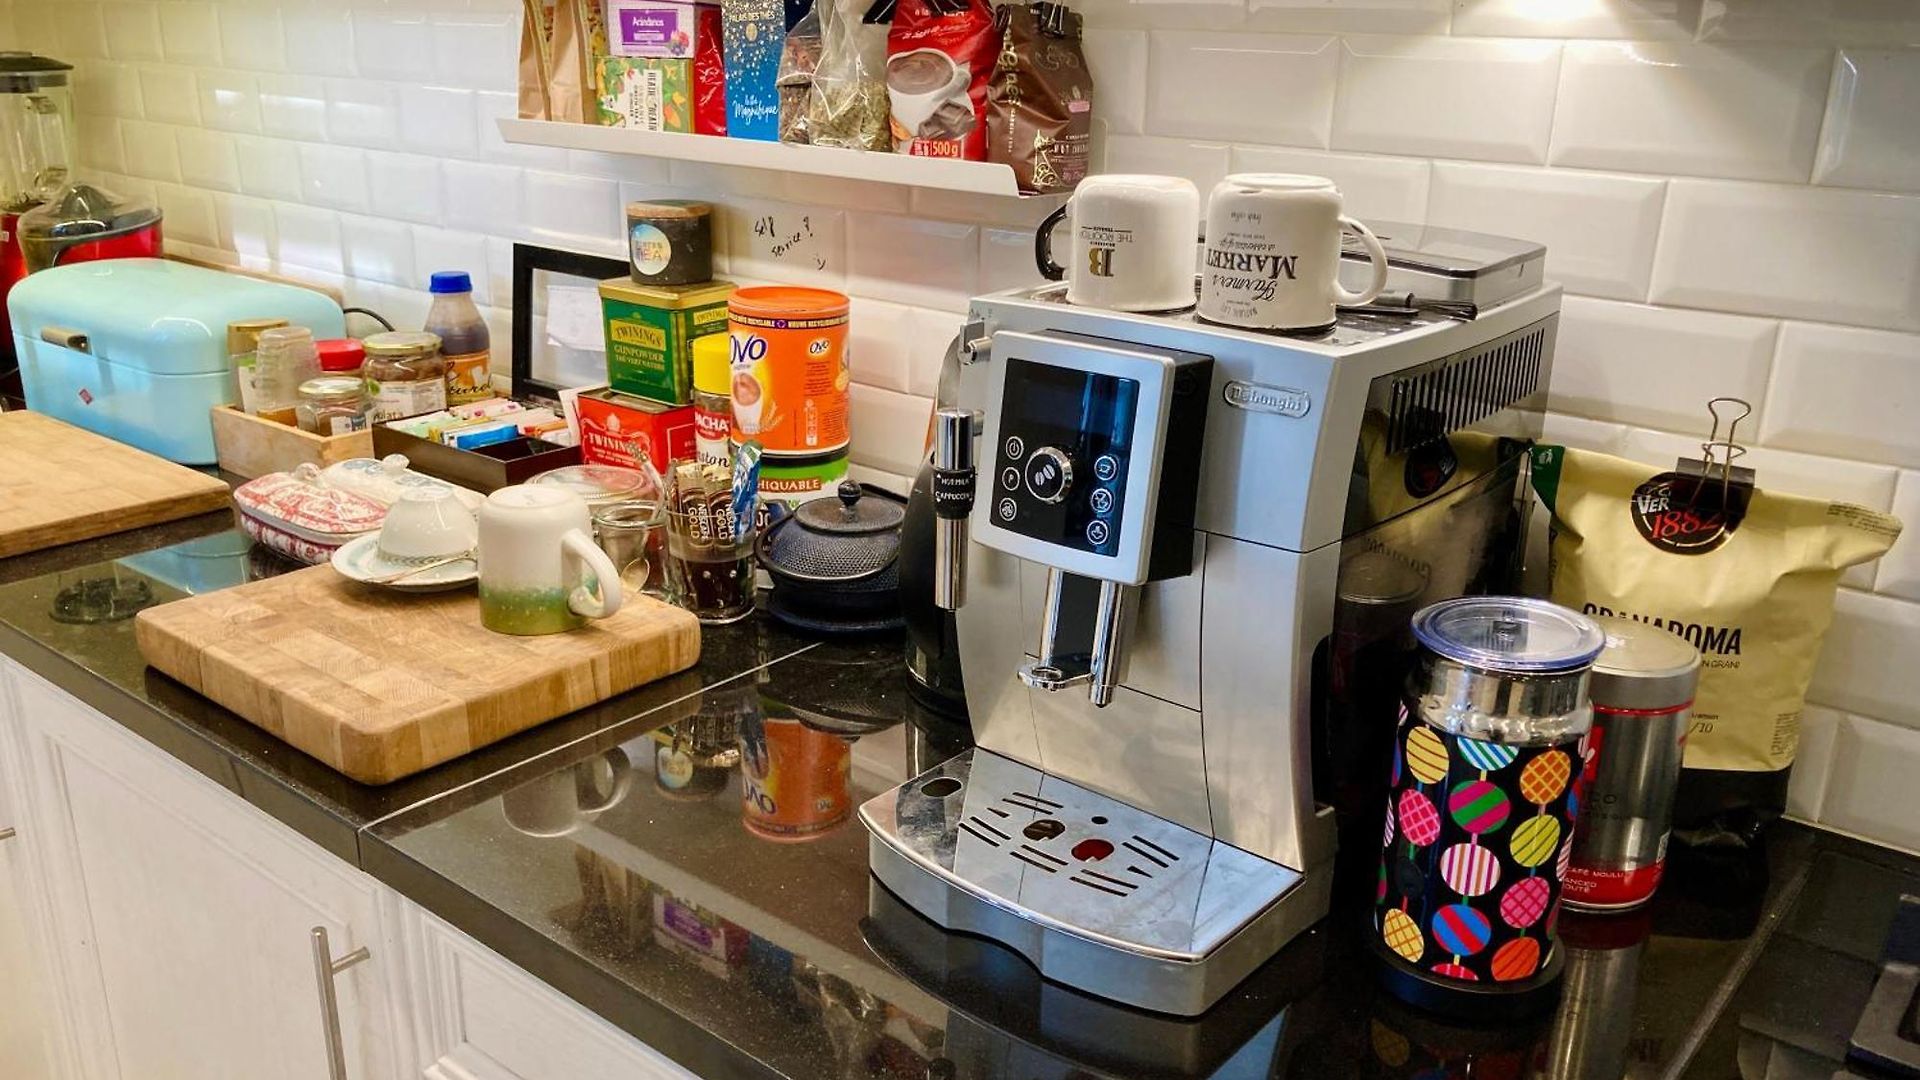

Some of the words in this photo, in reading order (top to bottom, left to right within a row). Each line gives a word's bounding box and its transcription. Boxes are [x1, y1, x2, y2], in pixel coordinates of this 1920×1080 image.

[932, 140, 951, 156] 500
[1117, 233, 1133, 243] THE
[636, 247, 662, 261] TEA
[1088, 247, 1115, 278] B
[1205, 248, 1299, 280] MARKET
[1212, 274, 1278, 302] Farmer's
[616, 325, 661, 346] TWININGS
[613, 344, 664, 361] GUNPOWDER
[588, 432, 628, 454] TWININ
[757, 479, 820, 491] HIQUABLE
[935, 490, 970, 500] CAPPUCCIN
[688, 507, 700, 539] GOLD
[715, 508, 728, 539] GOLD
[1651, 510, 1719, 540] 1882
[1711, 661, 1741, 670] GRANI
[1564, 878, 1597, 888] ANCED
[1593, 871, 1624, 879] MOULU
[1564, 883, 1591, 894] OUTÉ
